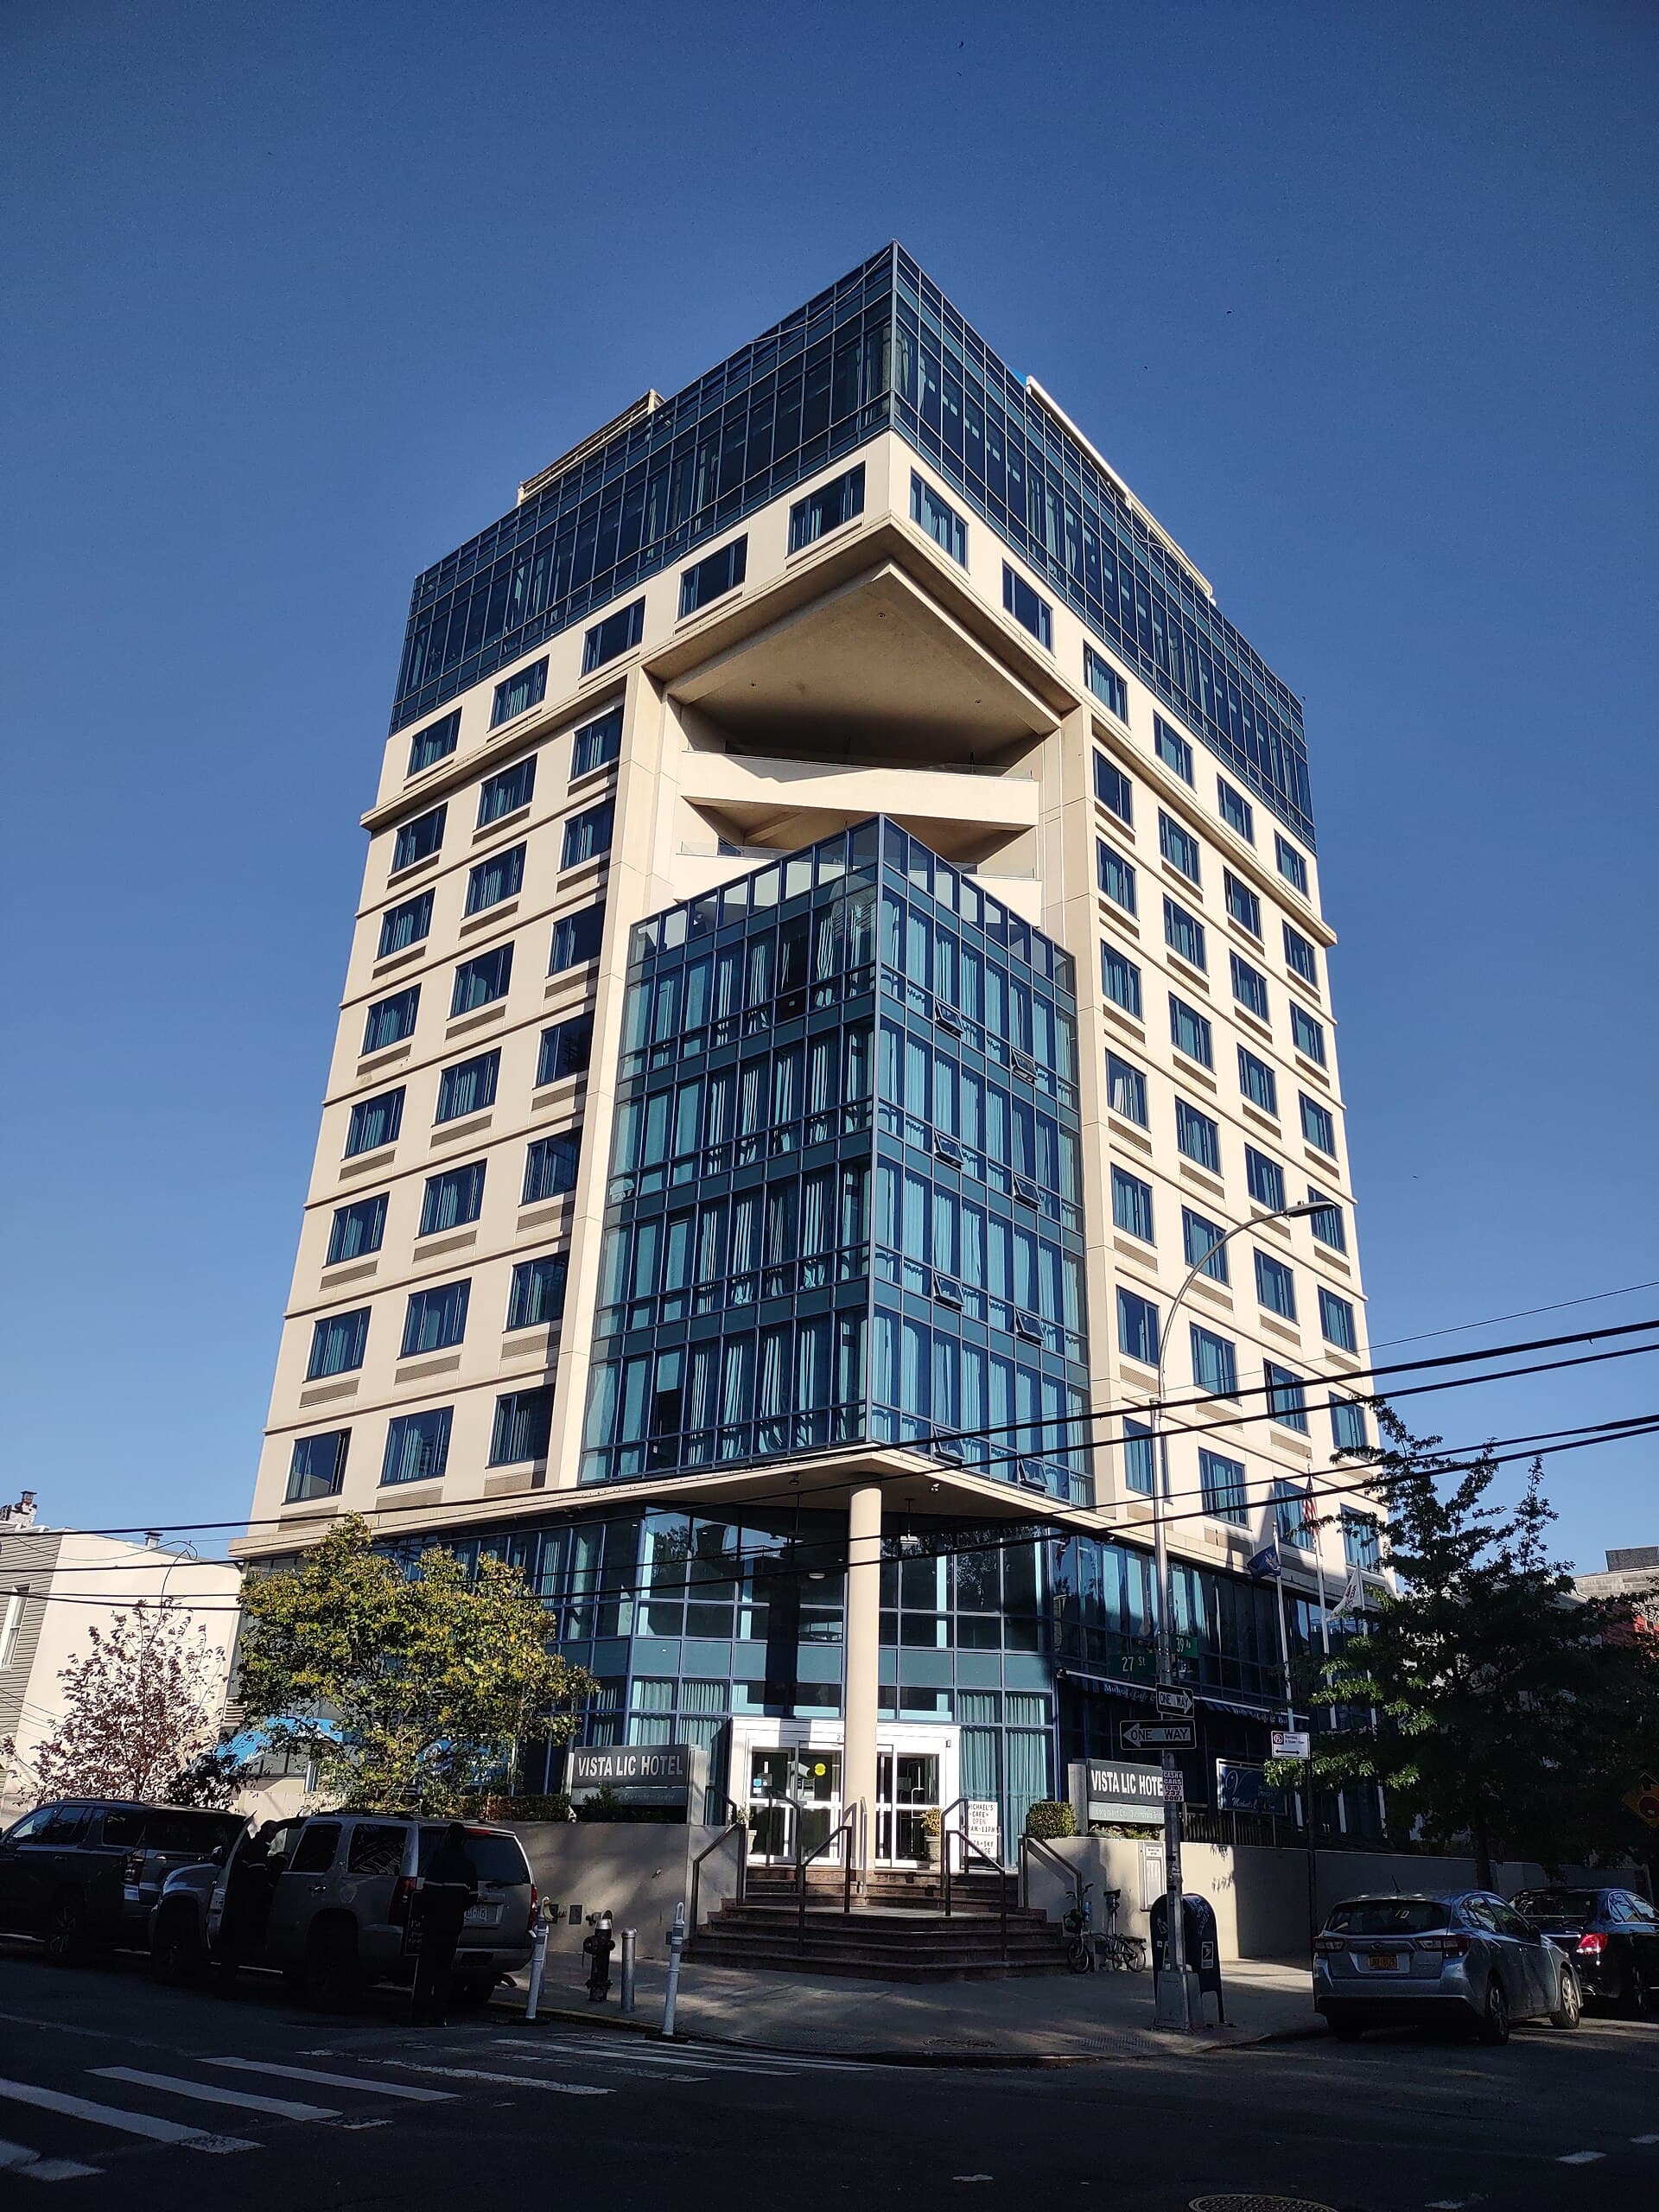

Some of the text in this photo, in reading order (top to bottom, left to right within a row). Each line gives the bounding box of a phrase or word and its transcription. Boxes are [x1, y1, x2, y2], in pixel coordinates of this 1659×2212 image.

[1175, 1637, 1185, 1653] 39
[1121, 1656, 1135, 1673] 27
[1160, 1693, 1188, 1708] ONE WAY
[1130, 1729, 1188, 1741] ONE WAY
[578, 1755, 683, 1777] VISTA LIC HOTEL
[1090, 1769, 1164, 1796] VISTA LIC HOTE
